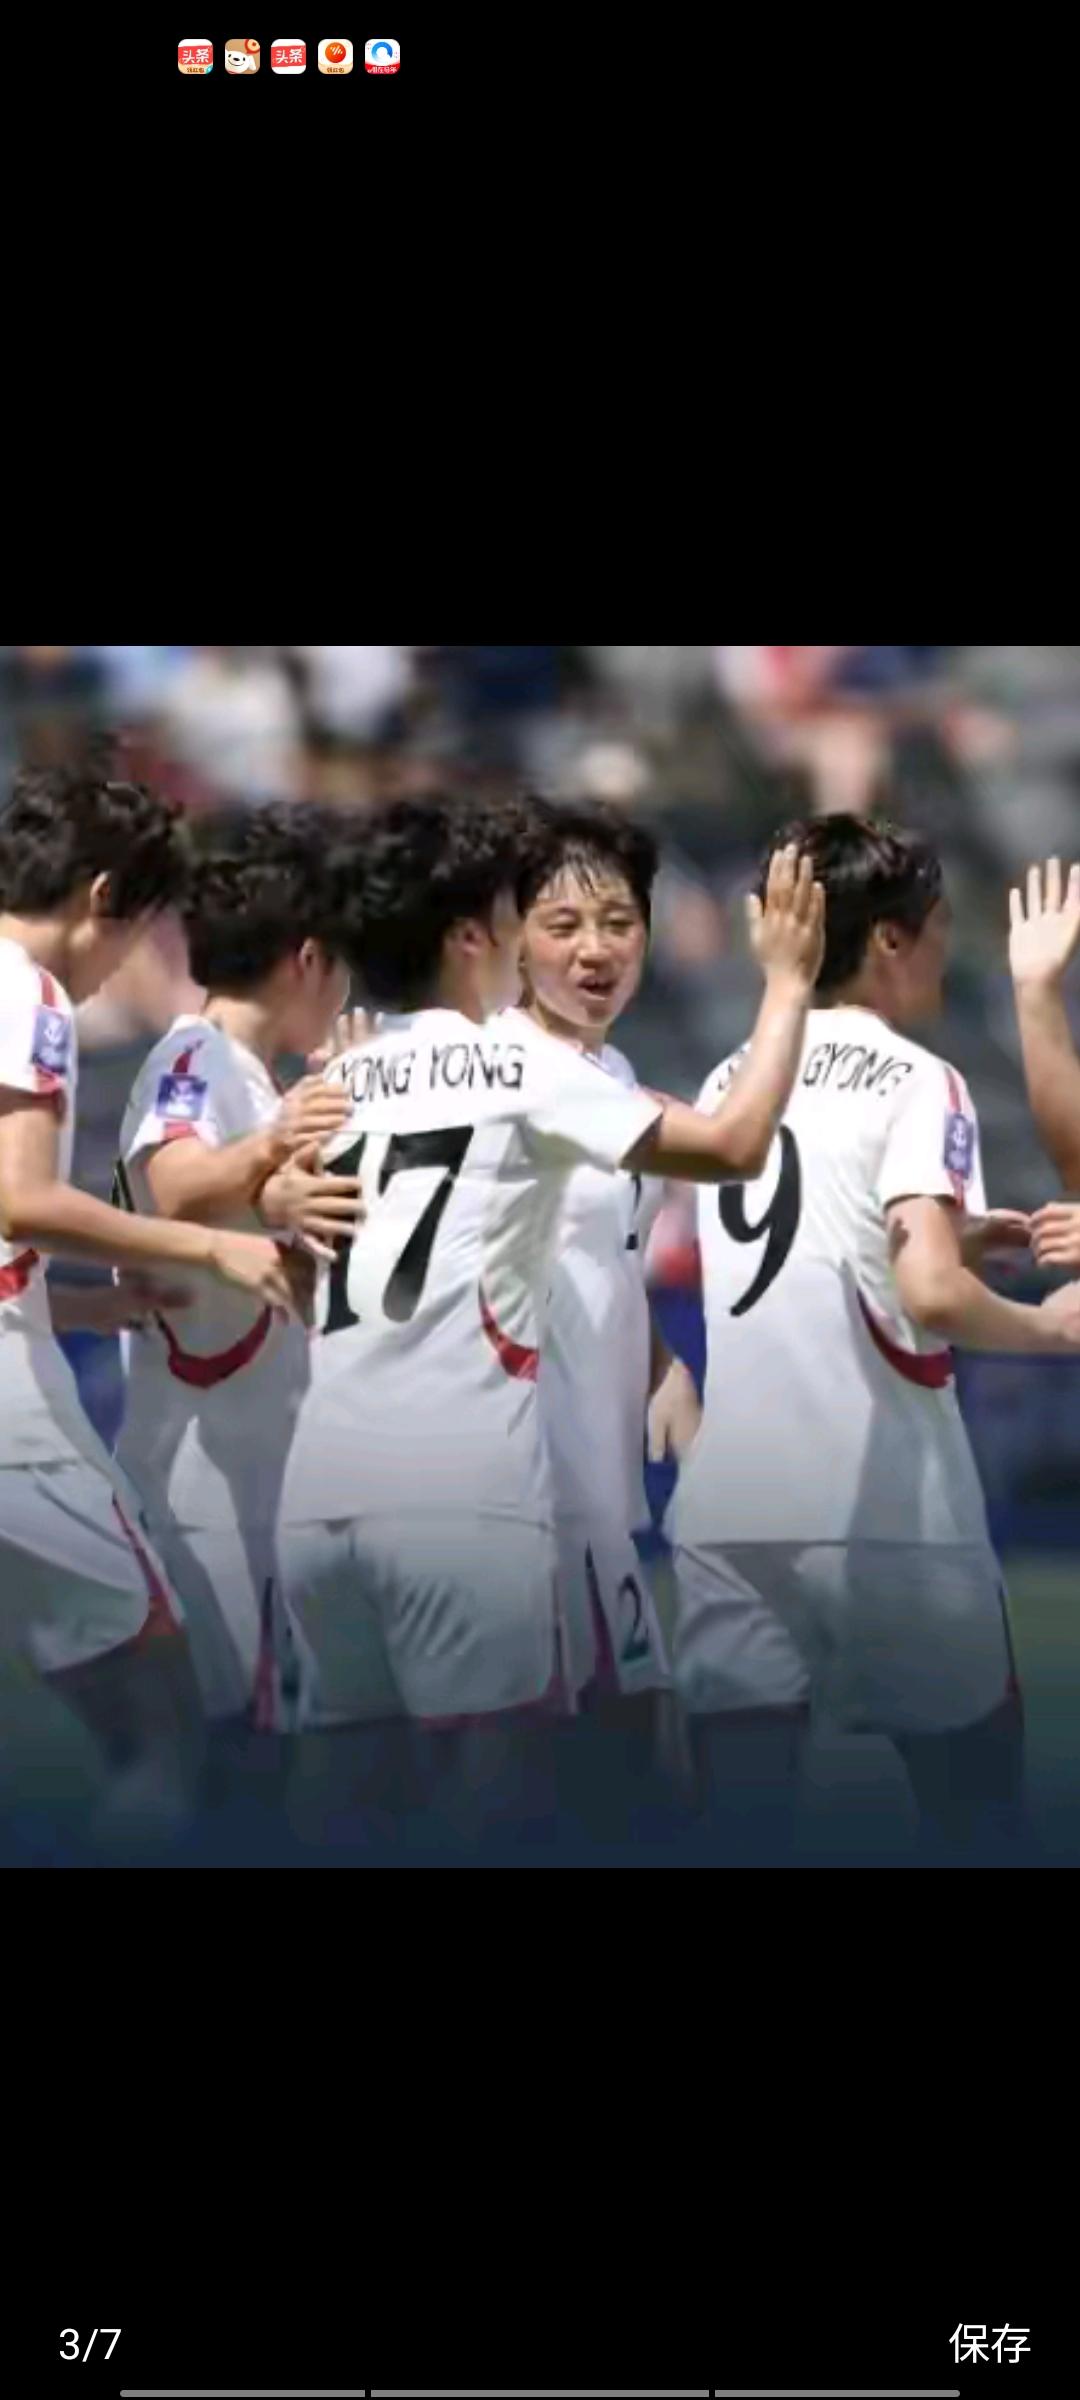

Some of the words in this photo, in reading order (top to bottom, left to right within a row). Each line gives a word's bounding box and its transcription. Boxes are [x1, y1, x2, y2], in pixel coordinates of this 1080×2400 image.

[430, 1043, 525, 1091] YONG
[802, 1043, 913, 1096] GYONG
[323, 1125, 474, 1336] 17
[718, 1123, 802, 1317] 9
[617, 1573, 650, 1663] 2
